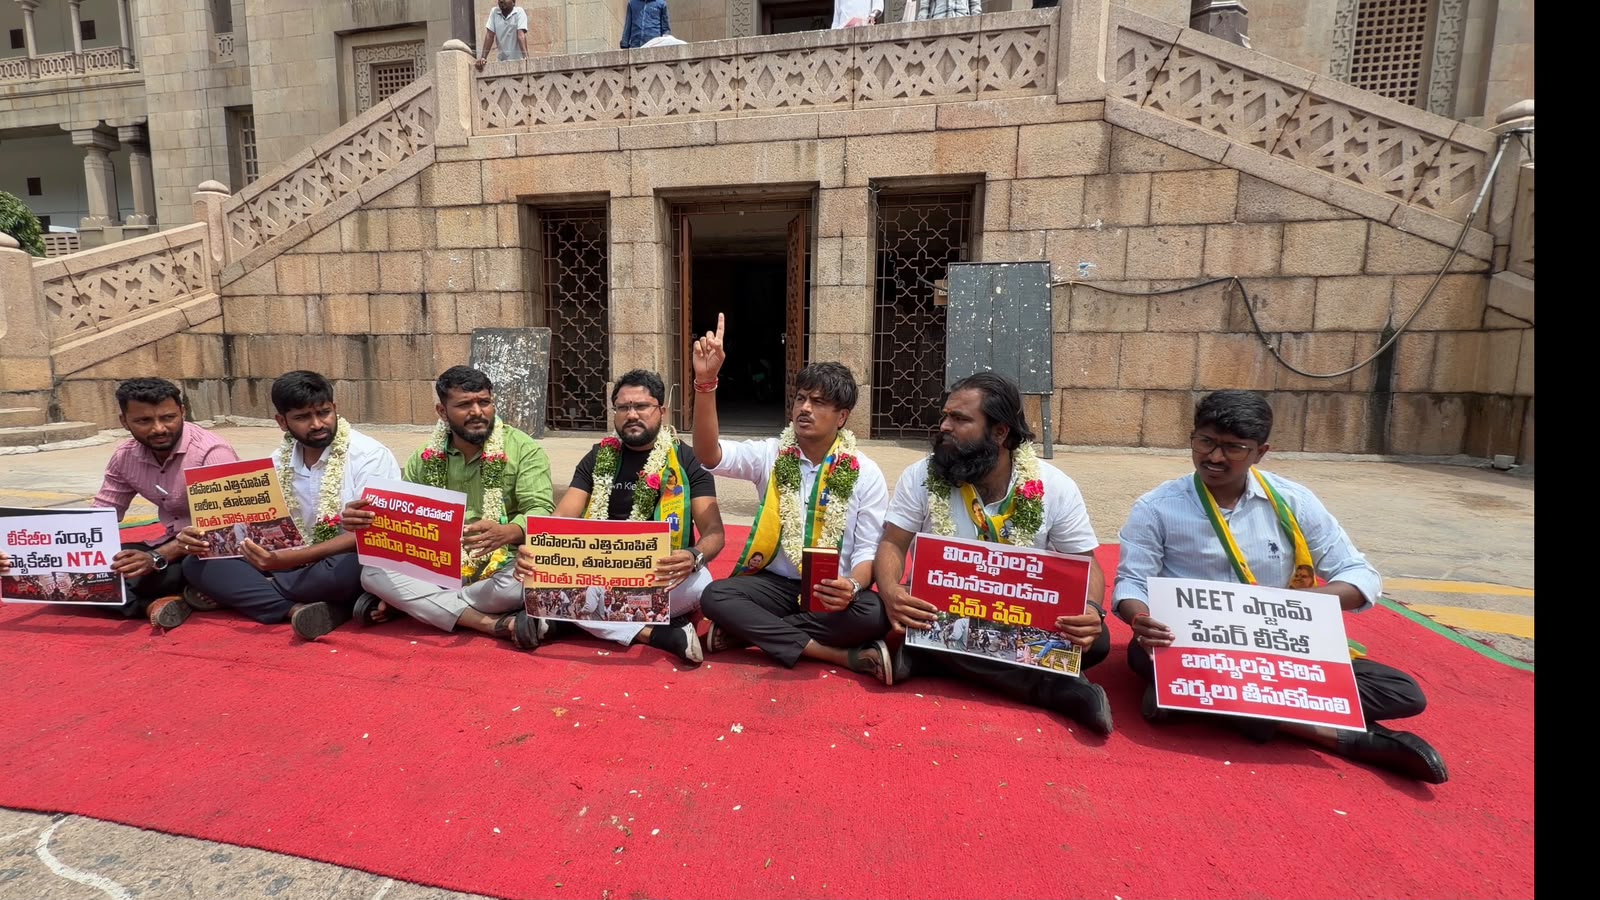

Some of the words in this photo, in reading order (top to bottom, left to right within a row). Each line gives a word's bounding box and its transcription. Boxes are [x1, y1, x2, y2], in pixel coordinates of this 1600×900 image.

[189, 481, 222, 496] లోపాలను
[223, 473, 270, 494] ఎత్తిచూపితే
[223, 491, 271, 508] తూటాలతో
[389, 498, 415, 514] UPSC
[415, 505, 454, 522] తరహాలో
[196, 514, 222, 528] గొంతు
[223, 507, 277, 526] నొక్కుతారా?
[371, 514, 440, 542] అటానమస్
[7, 529, 52, 546] లీకేజీల
[55, 527, 103, 548] సర్కార్
[364, 531, 404, 553] హోదా
[405, 543, 452, 568] ఇవ్వాలి
[530, 532, 586, 551] లోపాలను
[588, 537, 658, 555] ఎత్తిచూపితే
[8, 551, 63, 574] ప్యాకేజీల
[66, 550, 107, 567] NTA
[535, 553, 579, 568] లాఠీలు,
[582, 555, 653, 569] తూటాలతో
[943, 545, 1044, 580] విద్యార్థులపై
[532, 570, 573, 585] గొంతు
[575, 573, 656, 591] నొక్కుతారా?
[927, 568, 1060, 605] దమనకాండనా
[948, 594, 987, 619] షేమ్
[992, 601, 1032, 627] షేమ్
[1175, 587, 1235, 612] NEET
[1242, 596, 1313, 626] ఎగ్జామ్
[1188, 619, 1248, 647] పేపర్
[1253, 627, 1310, 654] లీకేజీ
[1181, 653, 1279, 683] బాధ్యులపై
[1278, 660, 1326, 683] కఠిన
[1168, 678, 1237, 706] చర్యలు
[1241, 683, 1351, 715] తీసుకోవాలి
